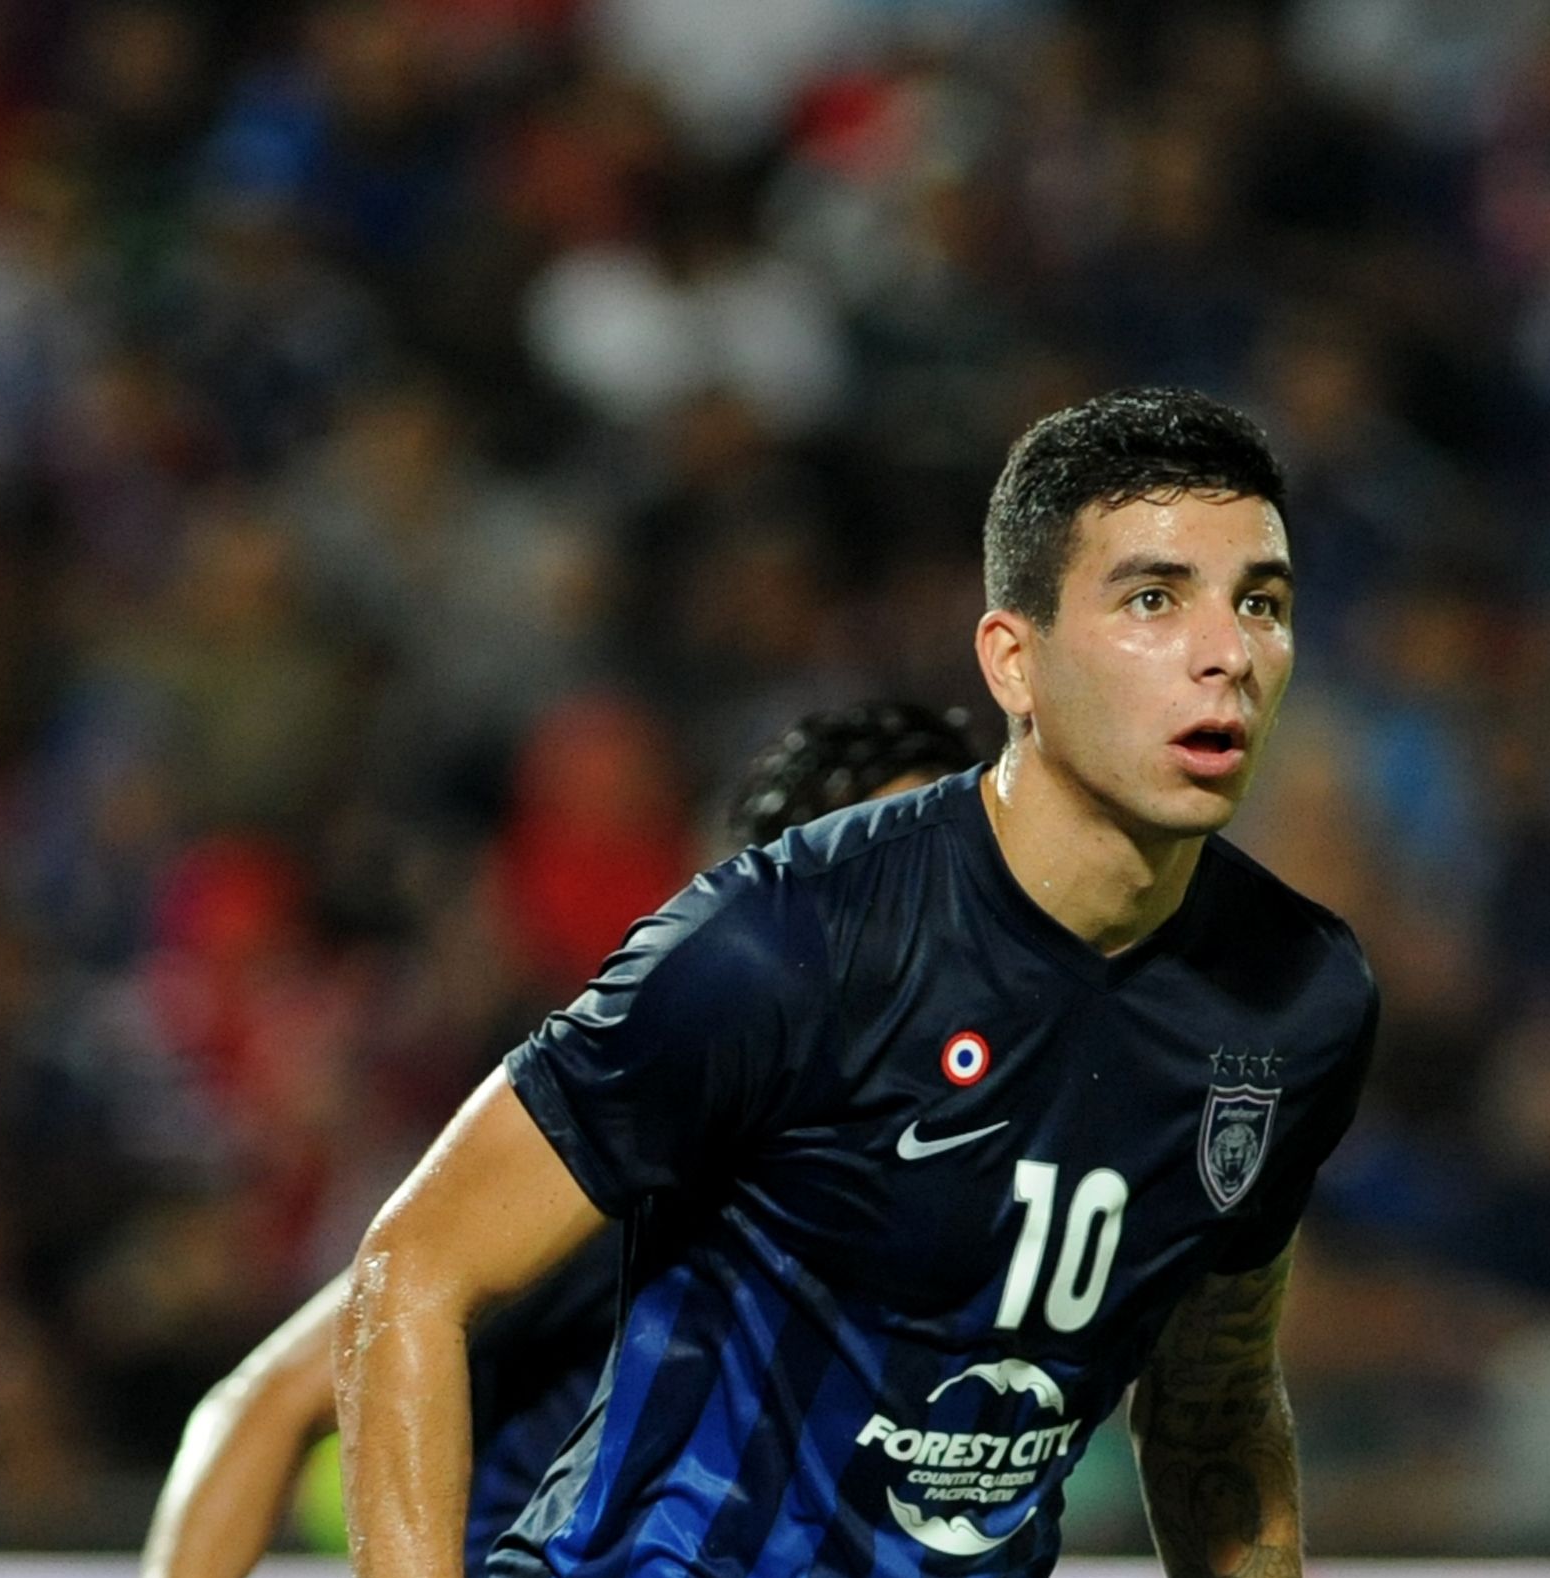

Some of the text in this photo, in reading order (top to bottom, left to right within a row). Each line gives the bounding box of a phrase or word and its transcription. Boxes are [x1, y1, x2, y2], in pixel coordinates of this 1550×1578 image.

[994, 1159, 1129, 1333] 10
[1010, 1418, 1083, 1467] CITY
[907, 1469, 981, 1486] COUNTRY
